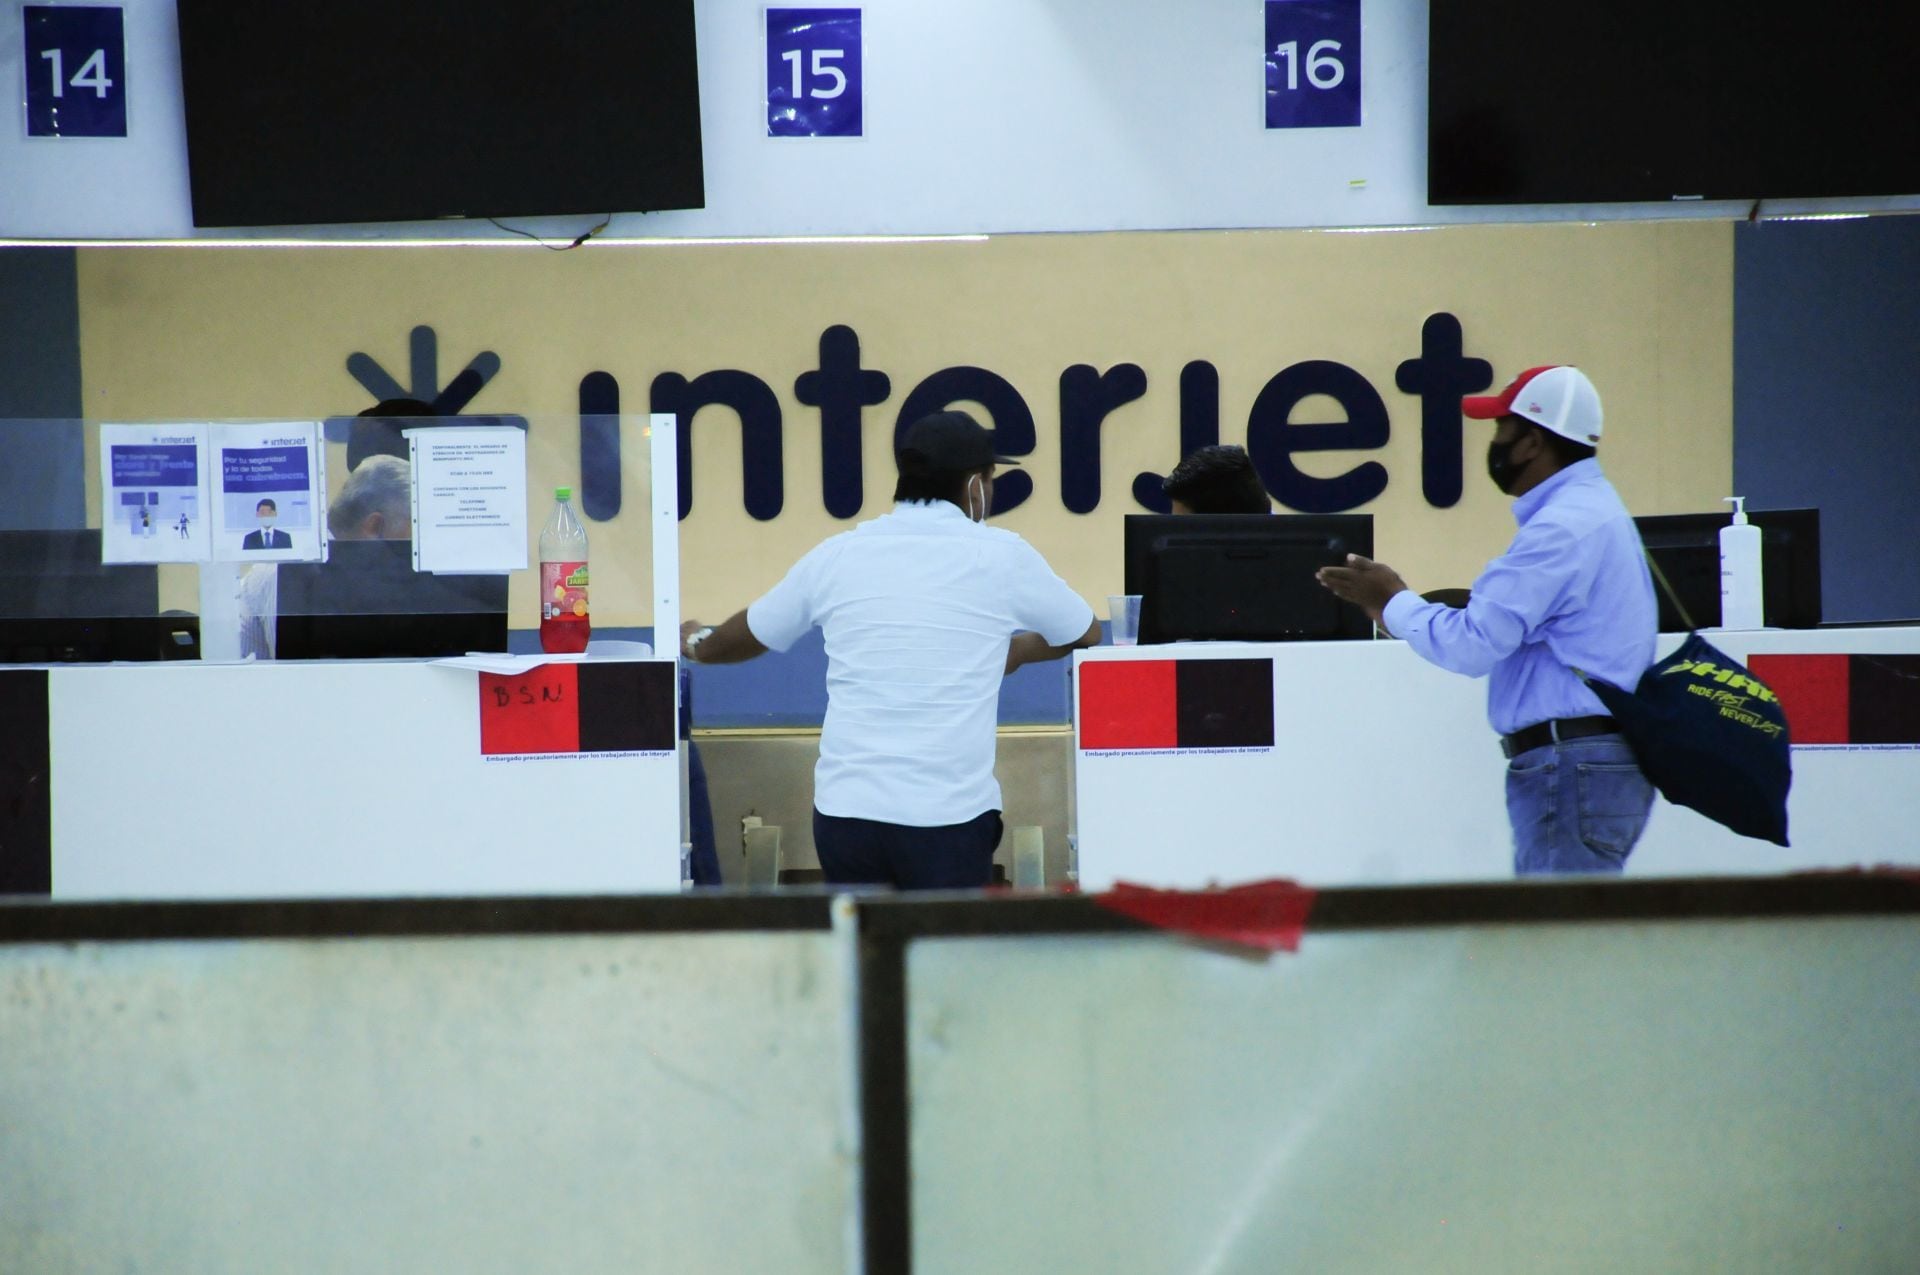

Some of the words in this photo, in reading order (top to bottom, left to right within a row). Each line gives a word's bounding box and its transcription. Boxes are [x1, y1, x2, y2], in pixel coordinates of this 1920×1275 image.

[41, 48, 112, 98] 14
[782, 49, 846, 99] 15
[1277, 39, 1344, 89] 16
[579, 312, 1494, 523] interjet
[1687, 684, 1715, 698] RIDE
[1711, 690, 1750, 707] FAST
[1719, 706, 1757, 726] NEVER
[600, 751, 640, 759] trabajadores
[1085, 750, 1120, 758] Embargado
[1198, 747, 1238, 755] trabajadores
